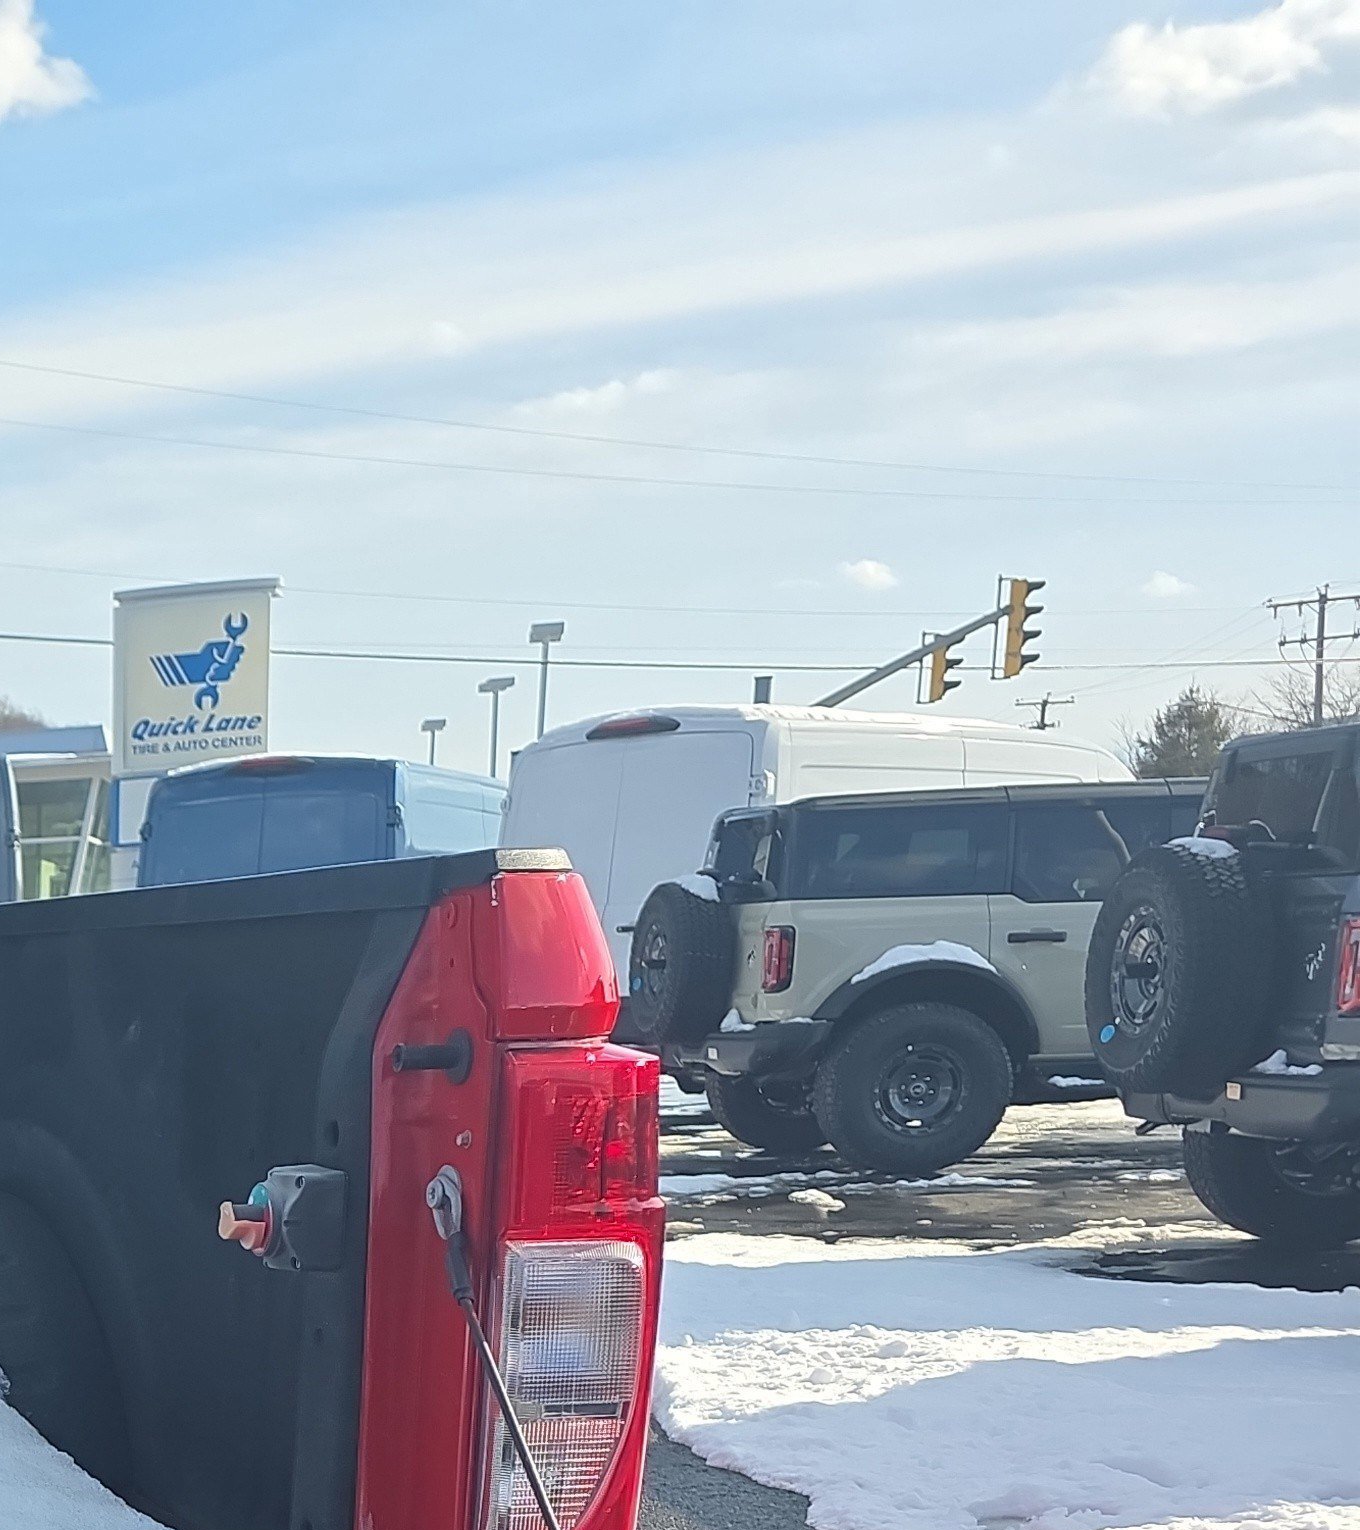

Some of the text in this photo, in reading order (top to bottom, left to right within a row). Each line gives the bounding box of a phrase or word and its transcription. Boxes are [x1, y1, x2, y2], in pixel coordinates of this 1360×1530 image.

[131, 714, 262, 741] Quick Lane
[173, 740, 209, 751] AUTO
[211, 735, 262, 749] CENTER
